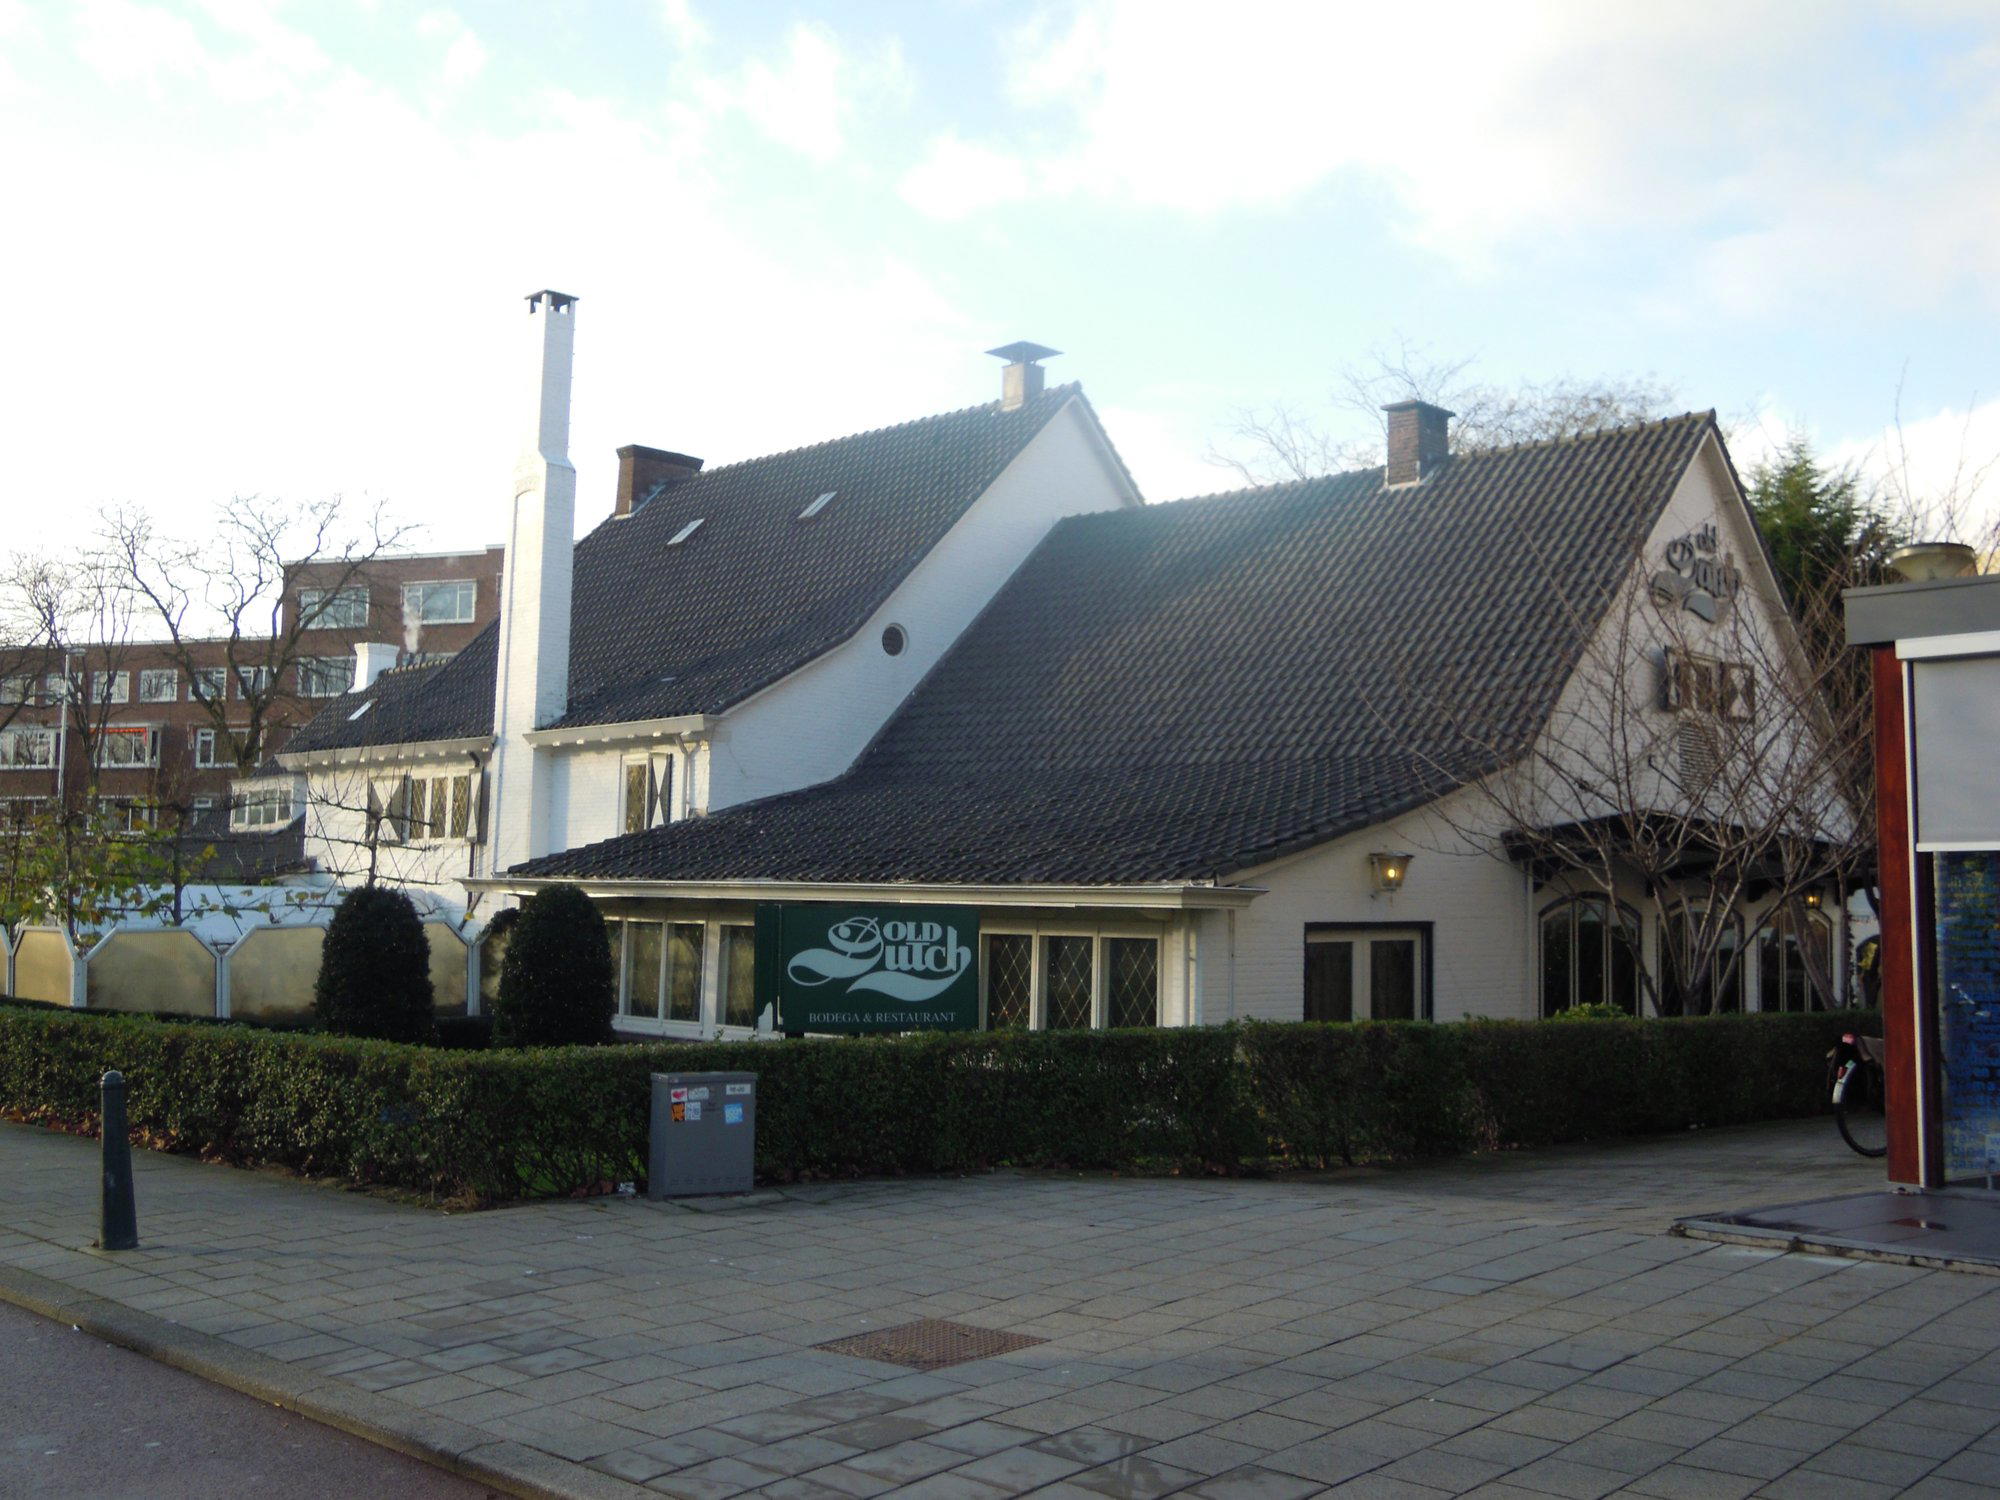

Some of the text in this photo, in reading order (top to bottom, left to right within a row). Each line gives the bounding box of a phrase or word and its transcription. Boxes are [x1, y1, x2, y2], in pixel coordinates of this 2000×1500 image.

[883, 921, 943, 942] OLD
[787, 917, 972, 1002] Dutch
[809, 1012, 956, 1023] BODEGA & RESTAURANT
